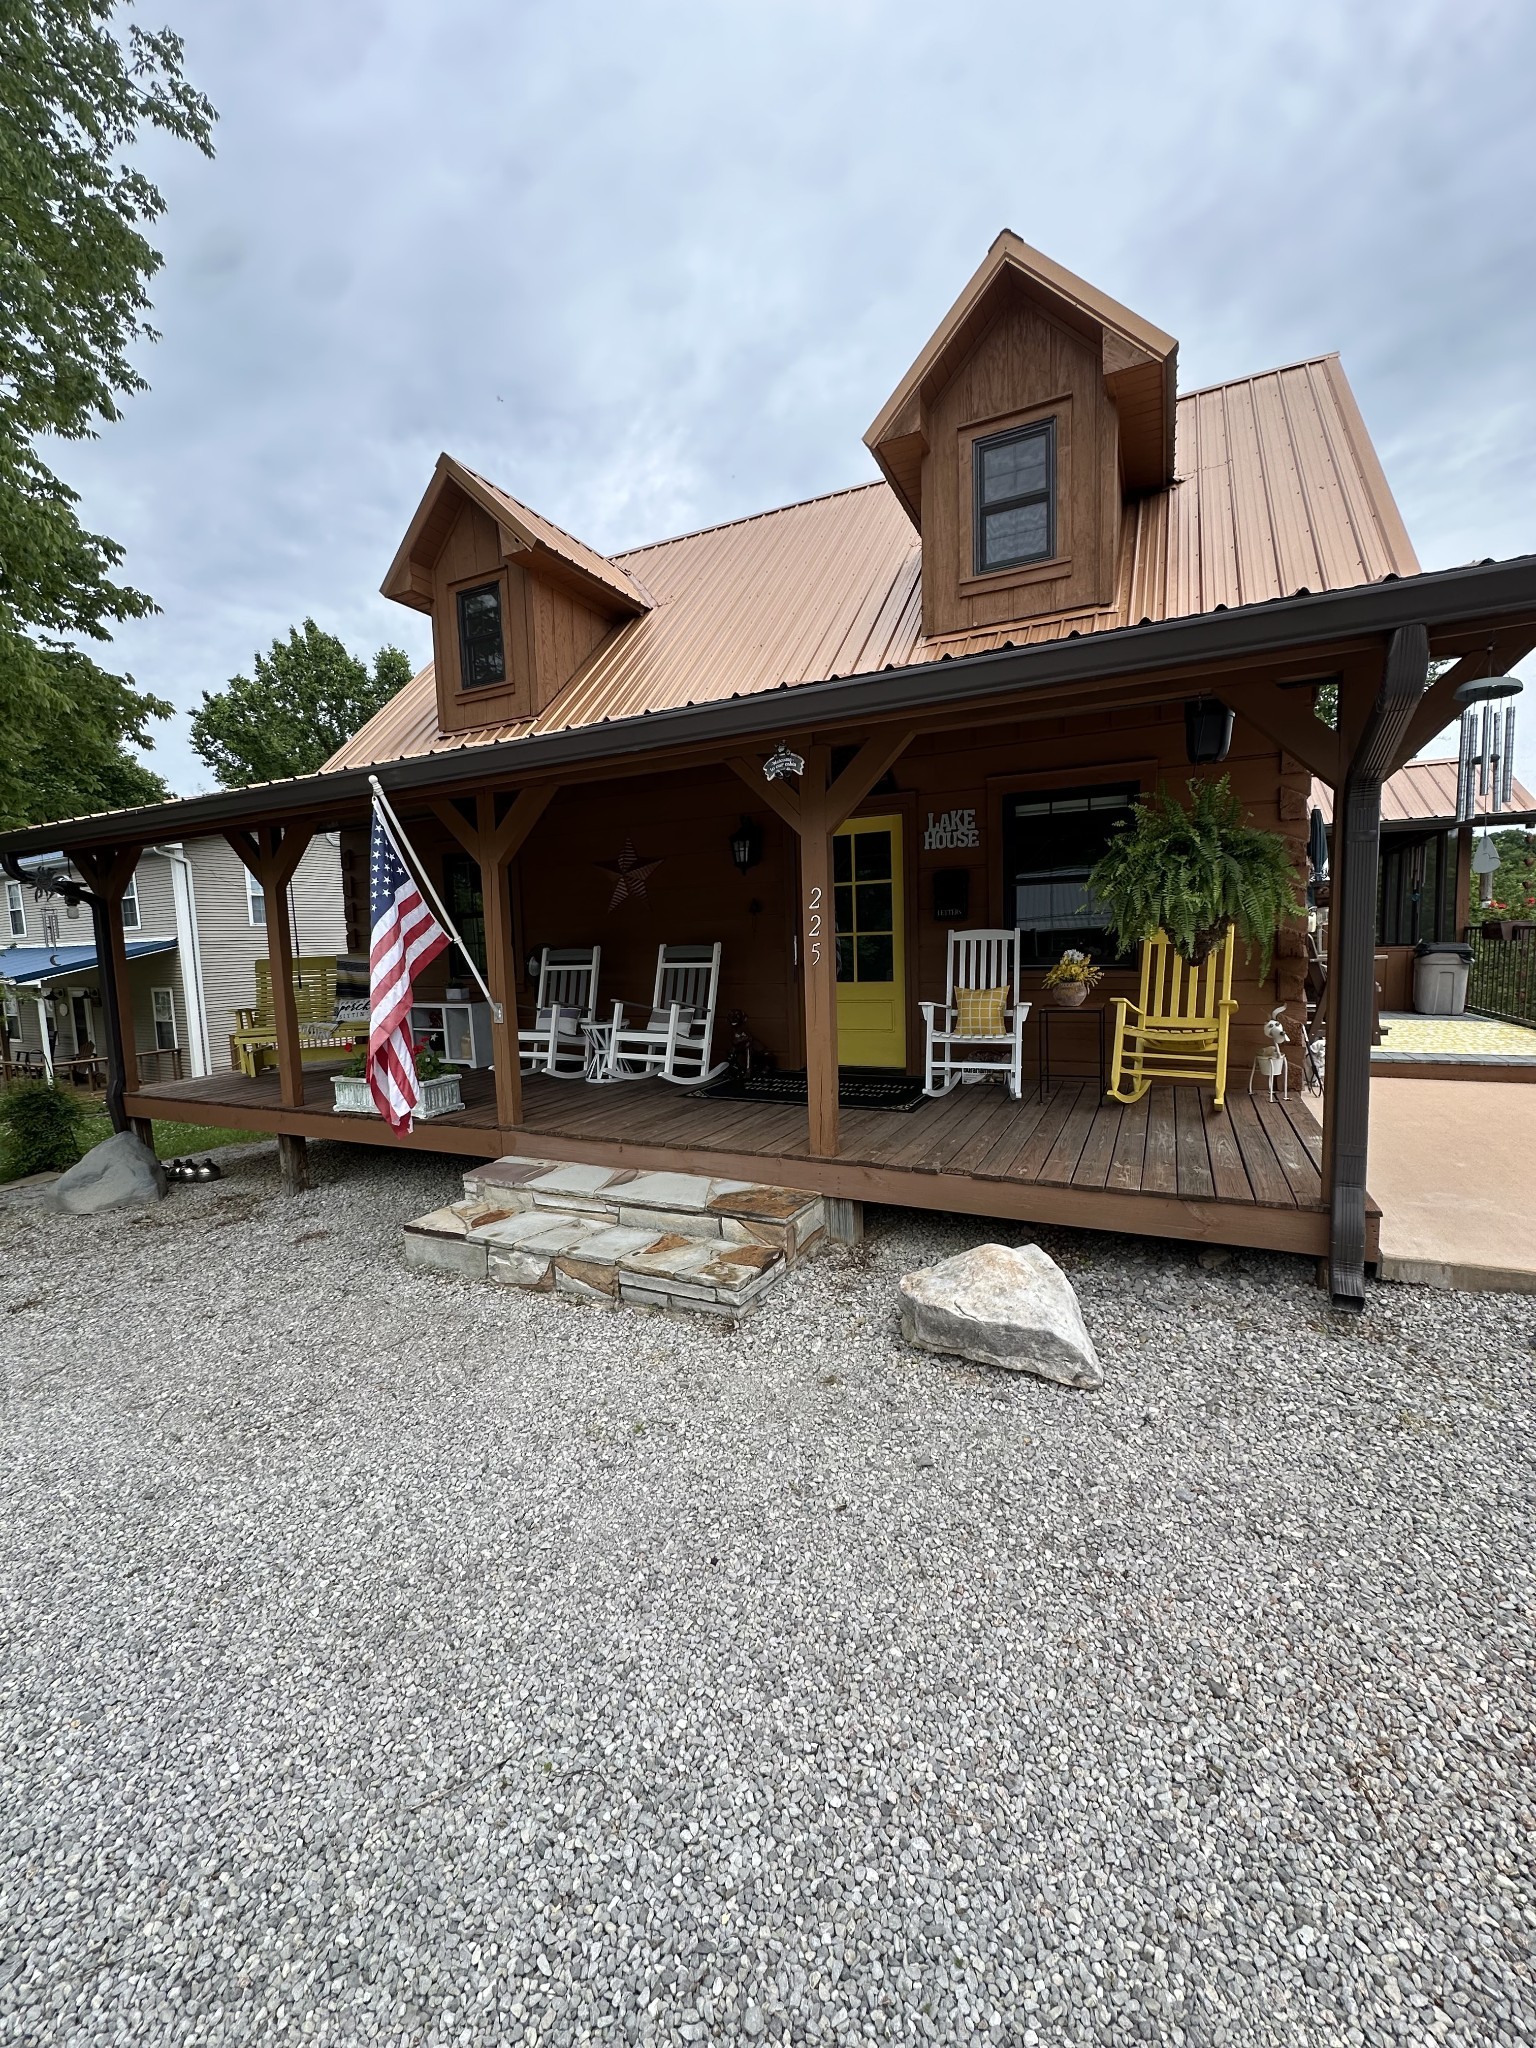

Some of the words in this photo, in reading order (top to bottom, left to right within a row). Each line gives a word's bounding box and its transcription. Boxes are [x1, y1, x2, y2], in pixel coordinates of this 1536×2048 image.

[928, 809, 976, 832] LAKE
[924, 830, 980, 850] HOUSE
[808, 887, 822, 966] 225
[336, 1000, 371, 1018] porch
